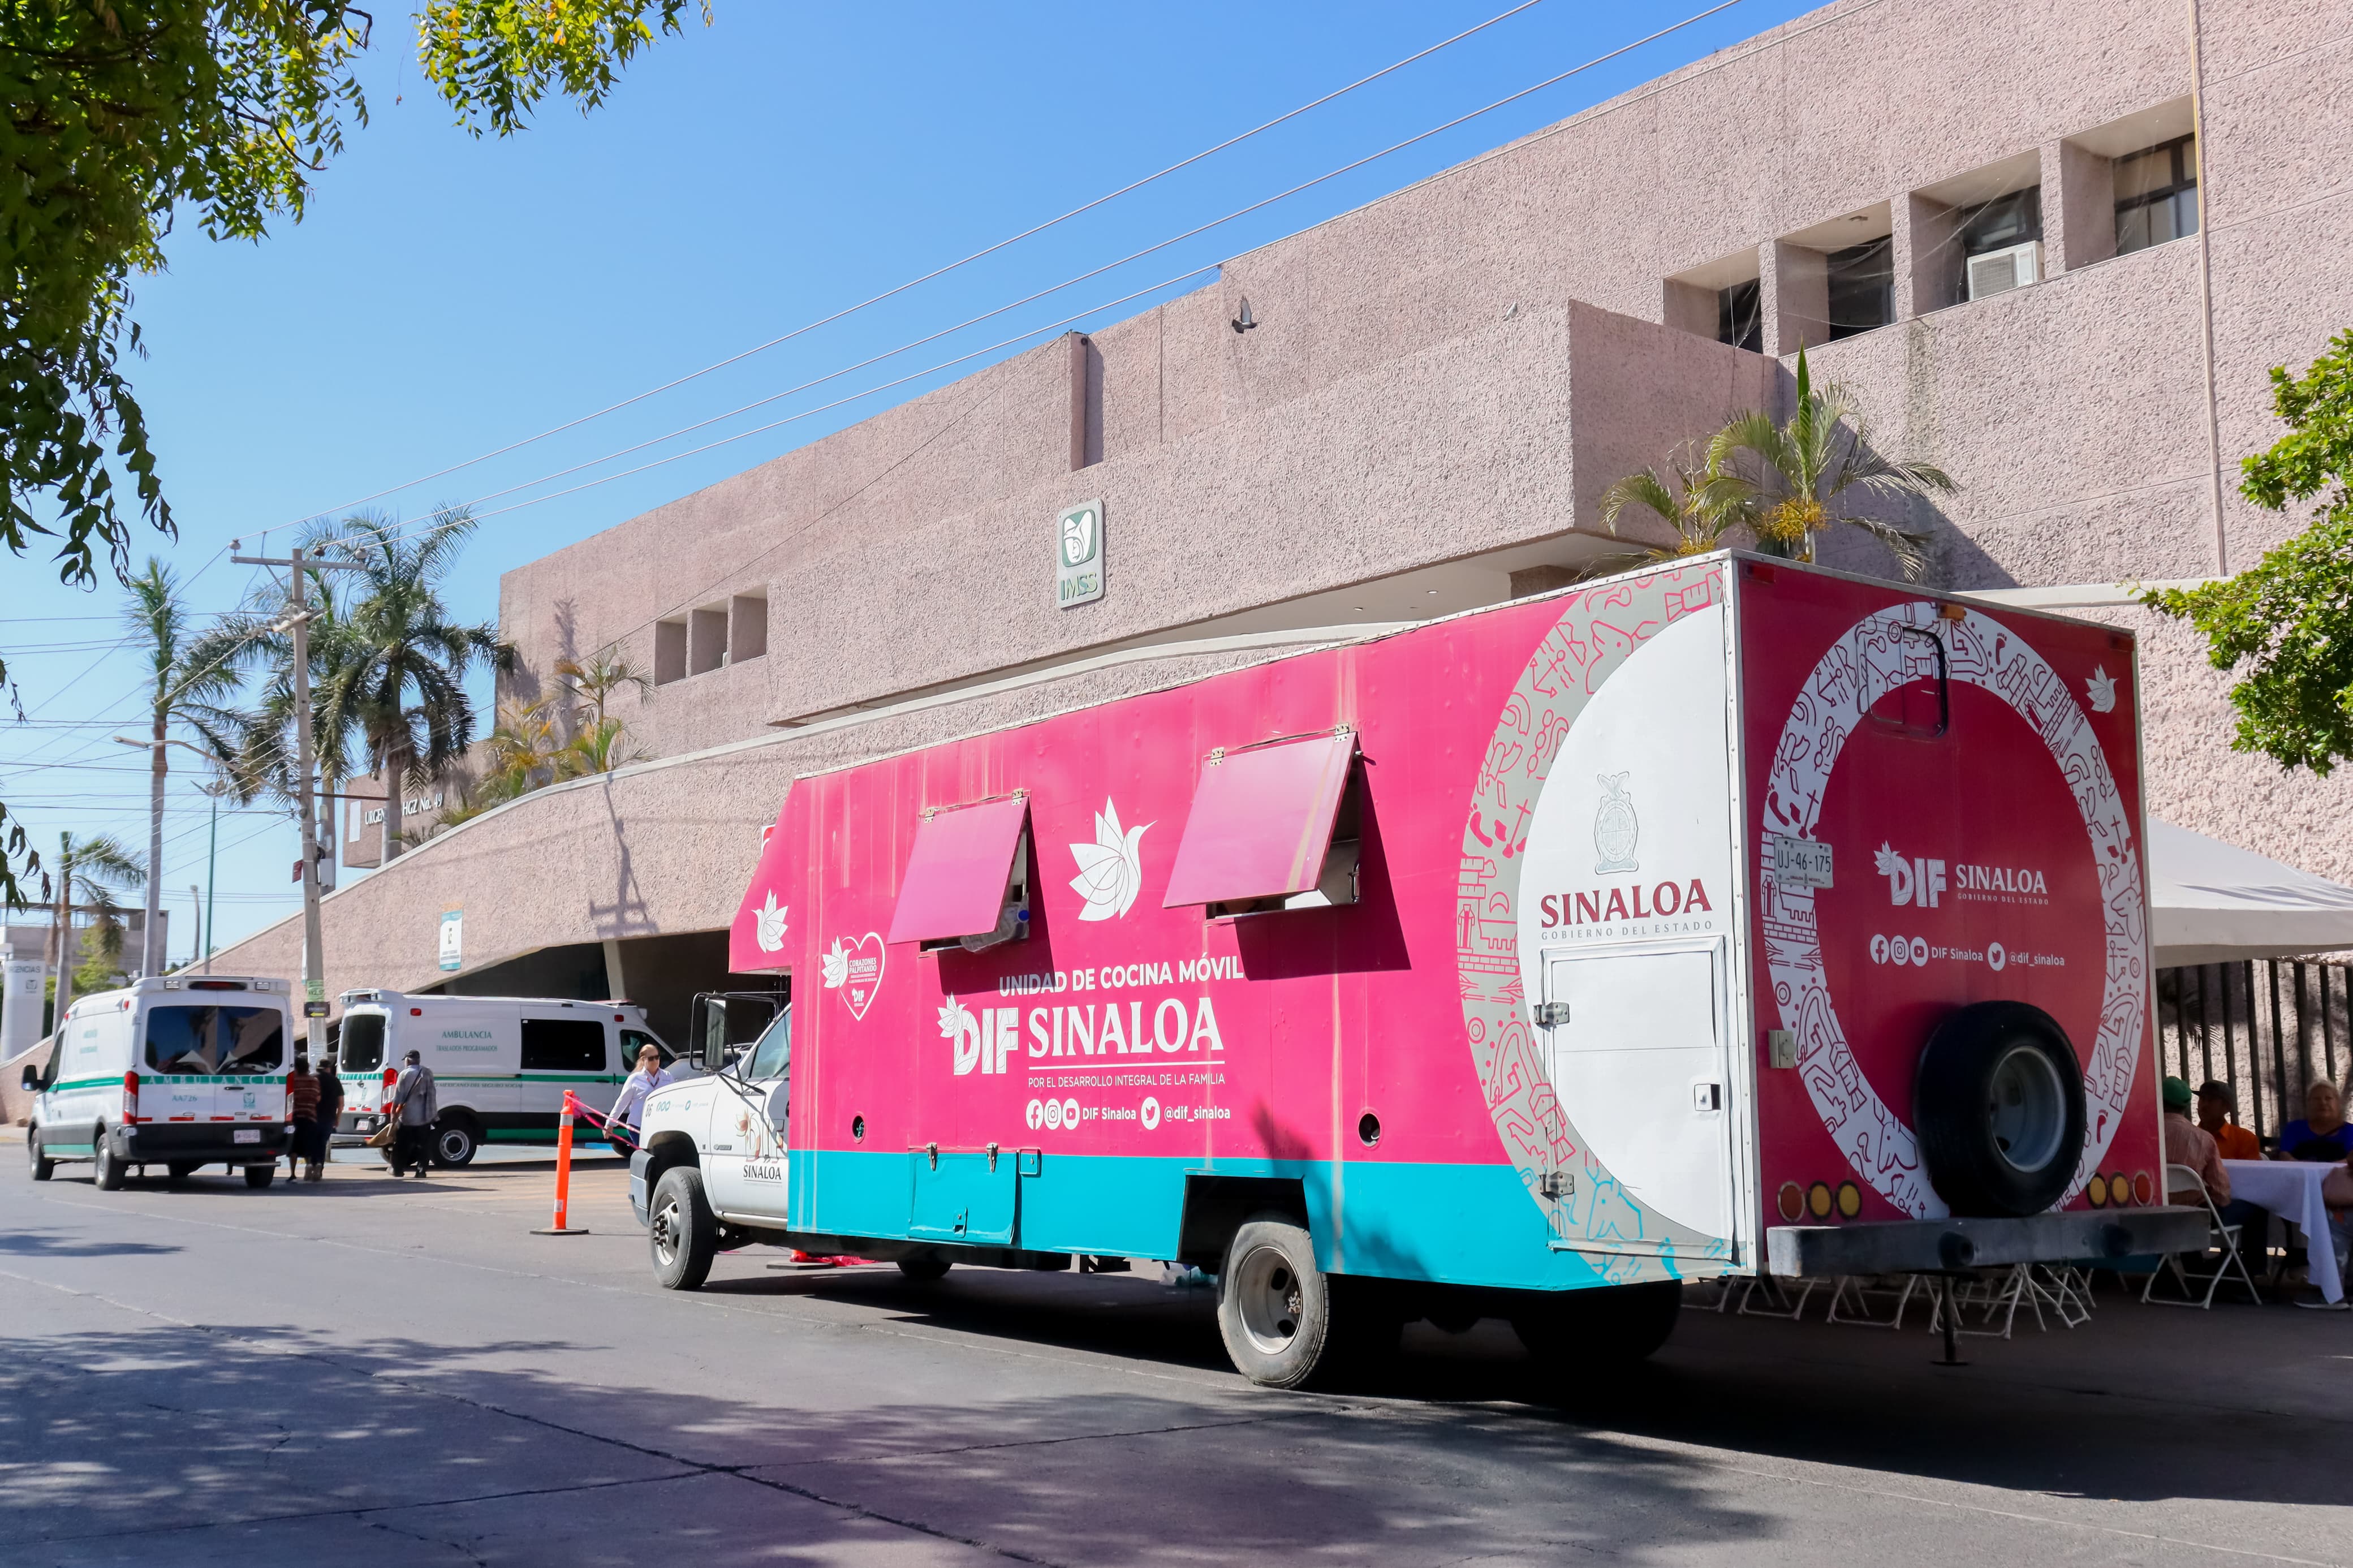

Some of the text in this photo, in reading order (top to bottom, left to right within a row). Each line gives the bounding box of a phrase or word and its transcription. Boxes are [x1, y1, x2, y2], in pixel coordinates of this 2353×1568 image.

[1061, 572, 1098, 600] IMSS
[365, 792, 443, 825] URGEN HGZ No. 49
[1778, 850, 1831, 873] UJ-46-175
[1890, 853, 2048, 908] DIF SINALOA
[1541, 878, 1713, 928] SINALOA
[1958, 893, 1998, 902] GOBIERNO
[2019, 897, 2049, 905] ESTADO
[1541, 920, 1712, 940] GOBIERNO DEL ESTADO
[849, 957, 877, 967] CORAZONES
[1932, 947, 2065, 967] DIF Sinaloa @dif_sinaloa
[849, 964, 877, 974] PALPITANDO
[999, 952, 1244, 997] UNIDAD DE COCINA MÓVIL
[854, 989, 864, 1002] DIF
[953, 997, 1225, 1075] DIF SINALOA
[149, 1076, 279, 1084] AMBULANCIA
[1028, 1073, 1225, 1088] POR EL DESARROLLO INTEGRAL DE LA FAMILIA
[1083, 1105, 1230, 1122] DIF Sinaloa @dif_sinaloa
[743, 1165, 781, 1180] SINALOA
